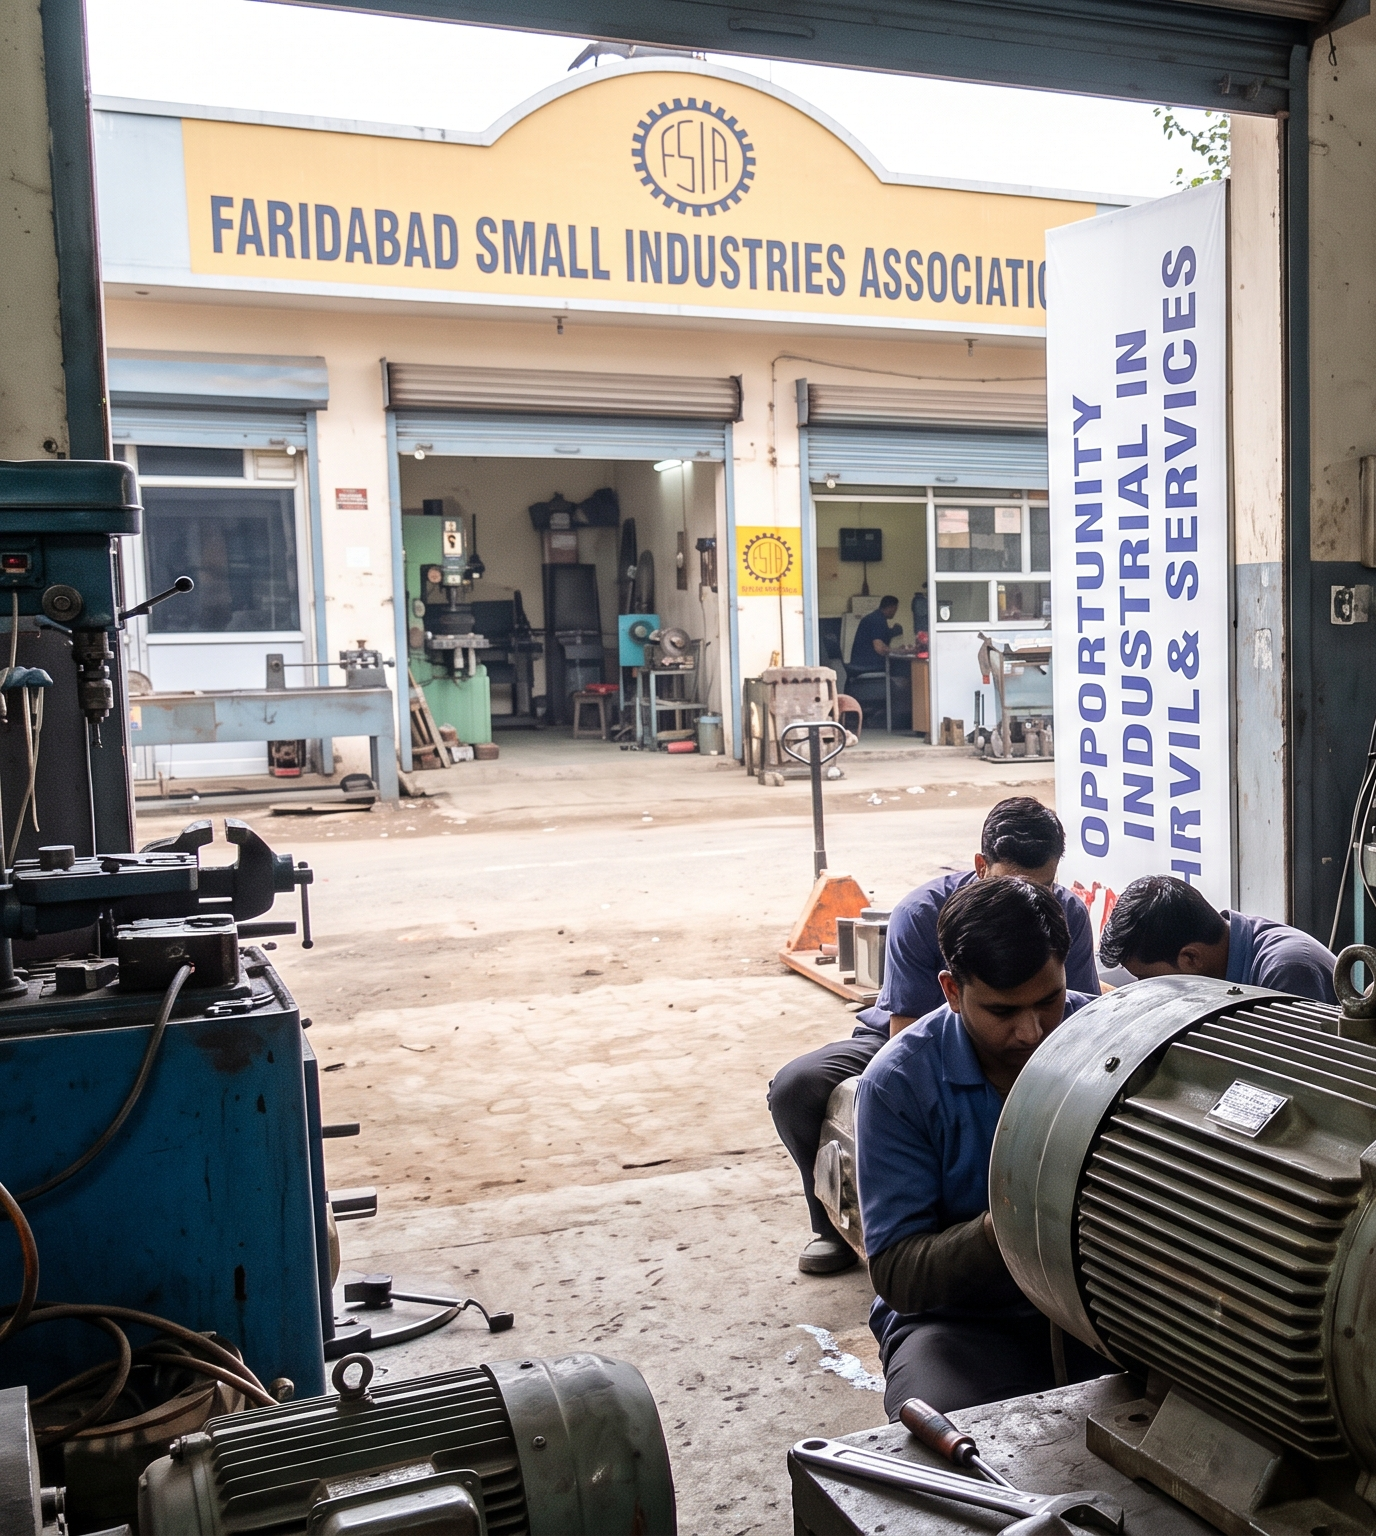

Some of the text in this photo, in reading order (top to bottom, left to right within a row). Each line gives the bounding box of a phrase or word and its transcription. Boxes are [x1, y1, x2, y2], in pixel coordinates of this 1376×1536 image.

[211, 195, 459, 269] FARIDABAD
[476, 217, 610, 280] SMALL
[625, 229, 846, 297] INDUSTRIES
[661, 120, 728, 194] FSIA
[1115, 329, 1155, 841] INDUSTRIAL IN
[1162, 246, 1199, 601] SERVICES
[1072, 395, 1109, 858] OPPORTUNITY
